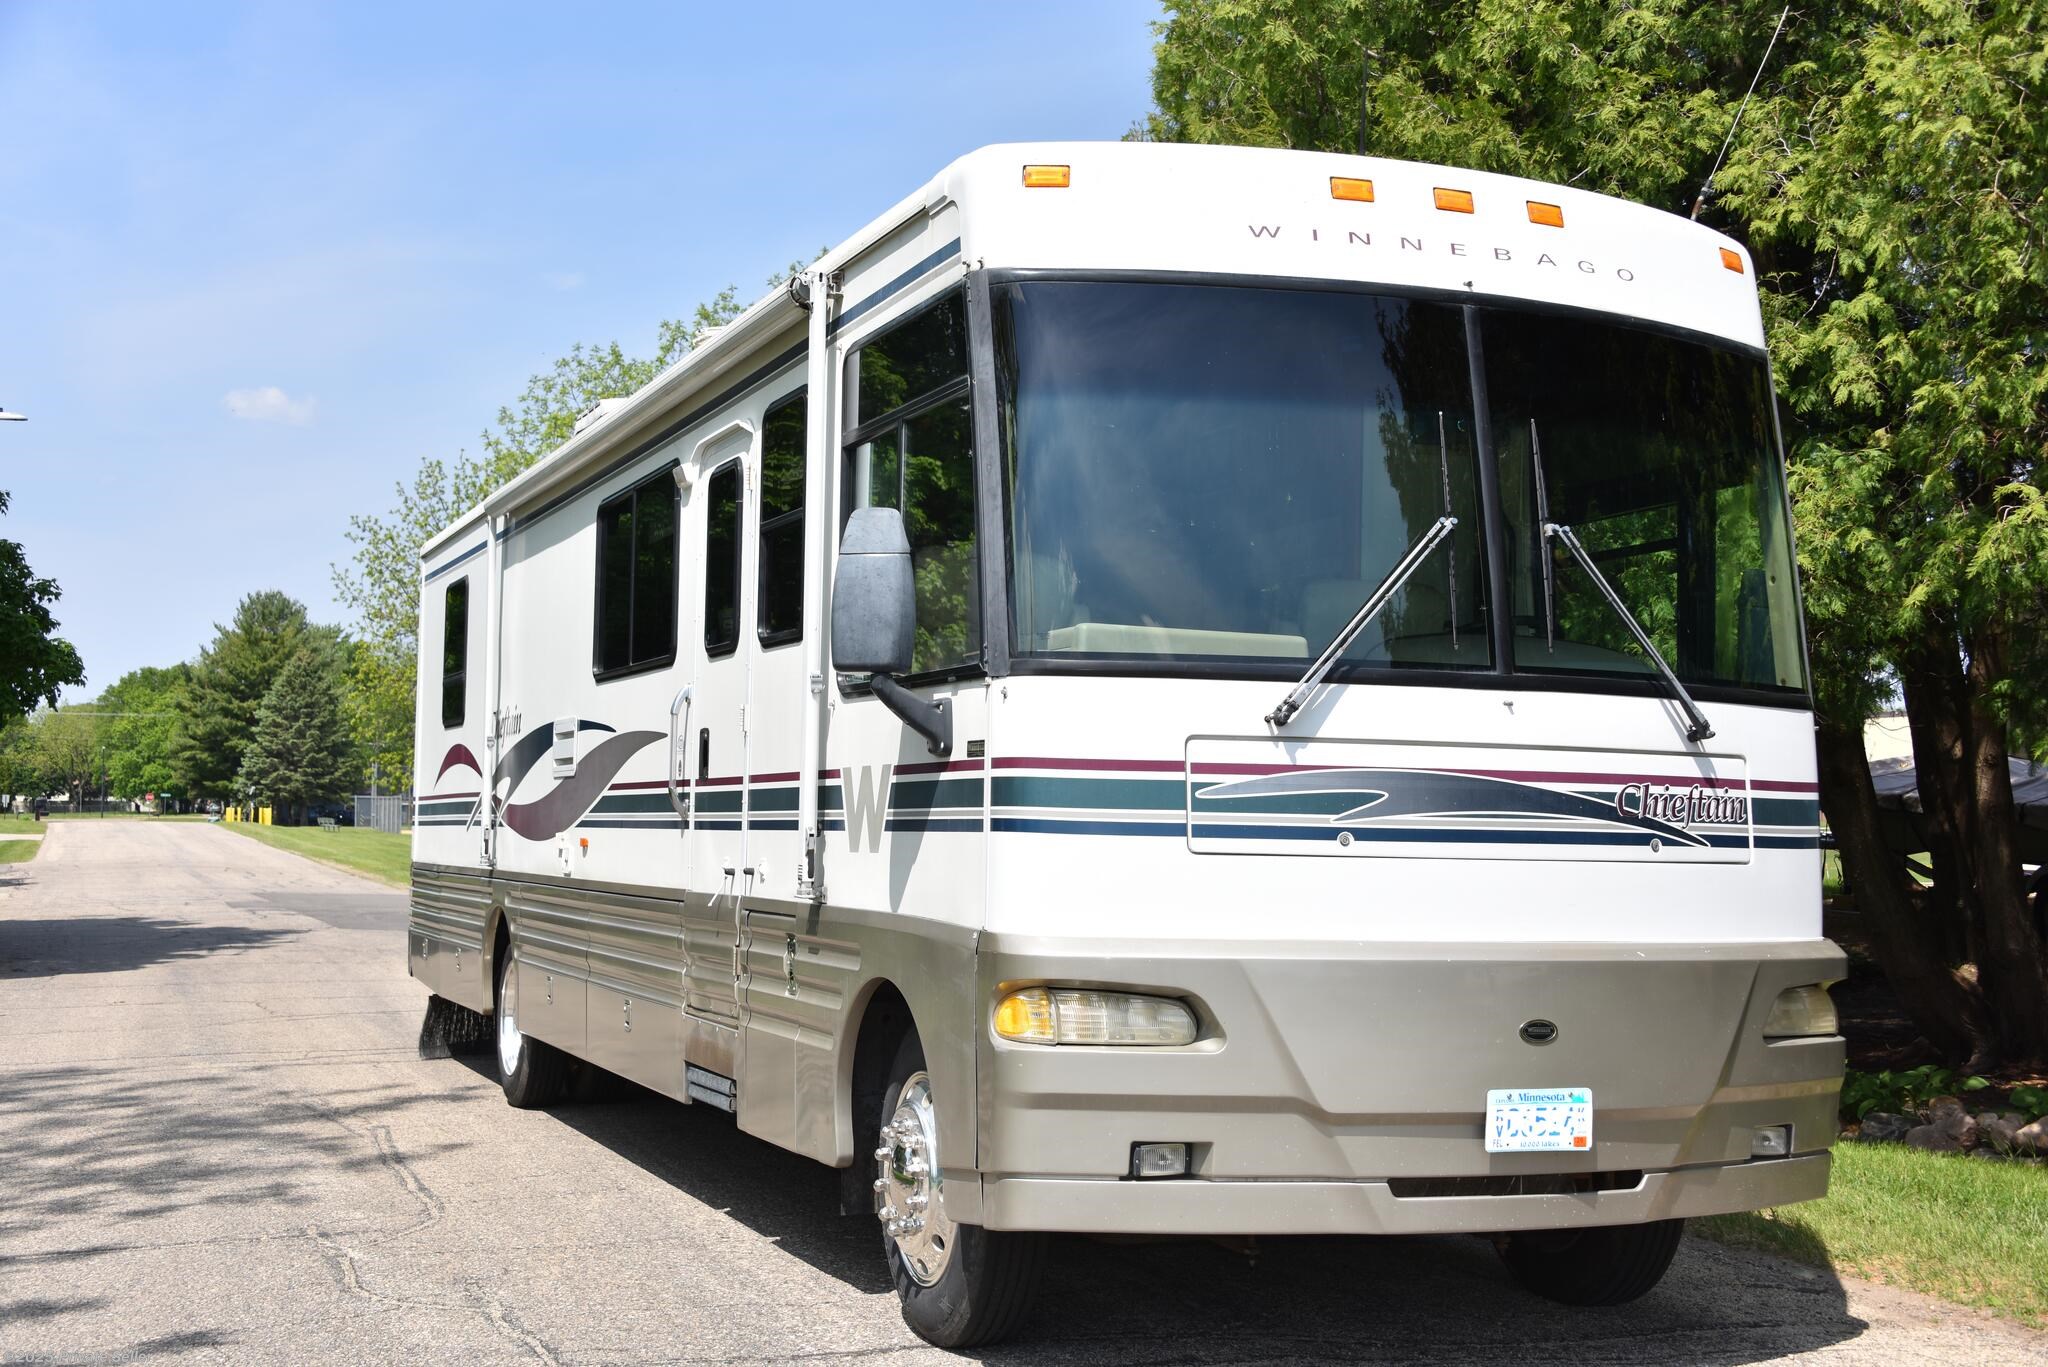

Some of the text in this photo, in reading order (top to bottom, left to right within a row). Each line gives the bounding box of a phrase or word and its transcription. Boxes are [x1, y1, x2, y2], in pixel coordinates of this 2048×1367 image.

[1247, 224, 1635, 282] WINNEBAGO
[841, 763, 892, 854] W
[1615, 783, 1747, 830] Chieftain
[1518, 1092, 1566, 1102] Minnesota
